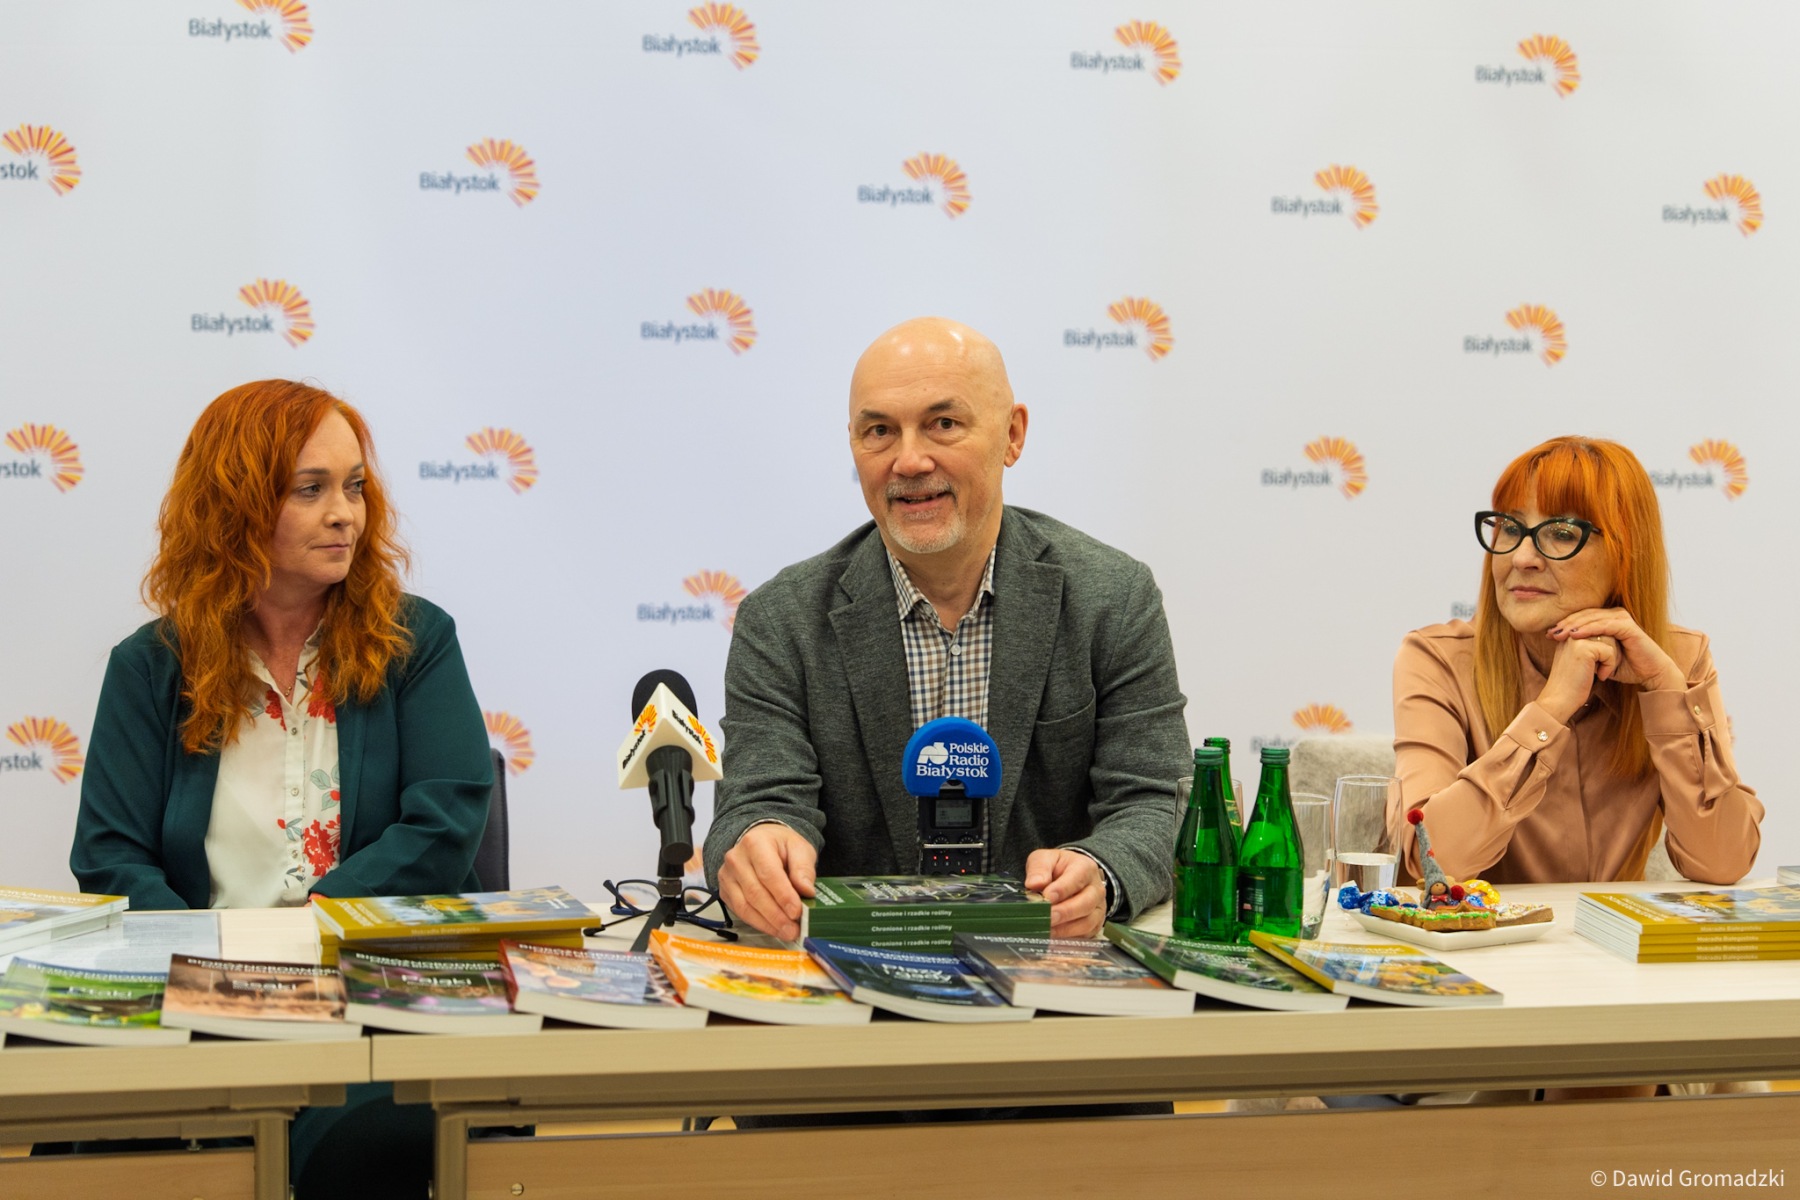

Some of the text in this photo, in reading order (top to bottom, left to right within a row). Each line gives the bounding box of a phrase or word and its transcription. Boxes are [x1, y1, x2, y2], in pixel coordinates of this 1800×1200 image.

[188, 17, 271, 41] Białystok
[642, 34, 722, 58] Białystok
[1070, 51, 1145, 74] Białystok
[1475, 65, 1546, 86] Białystok
[419, 171, 500, 195] Białystok
[857, 185, 933, 208] Białystok
[1270, 196, 1343, 217] Białystok
[1662, 205, 1730, 224] Białystok
[191, 312, 274, 337] Białystok
[640, 321, 719, 344] Białystok
[1063, 329, 1137, 350] Białystok
[1463, 336, 1533, 356] Białystok
[0, 458, 42, 479] stok
[419, 461, 499, 483] Białystok
[1261, 469, 1333, 489] Białystok
[637, 602, 714, 625] Białystok
[949, 743, 990, 754] Polskie
[949, 754, 990, 766] Radio
[916, 763, 989, 779] Białystok
[931, 909, 952, 918] rośliny
[931, 924, 952, 933] rośliny
[931, 939, 952, 948] rośliny
